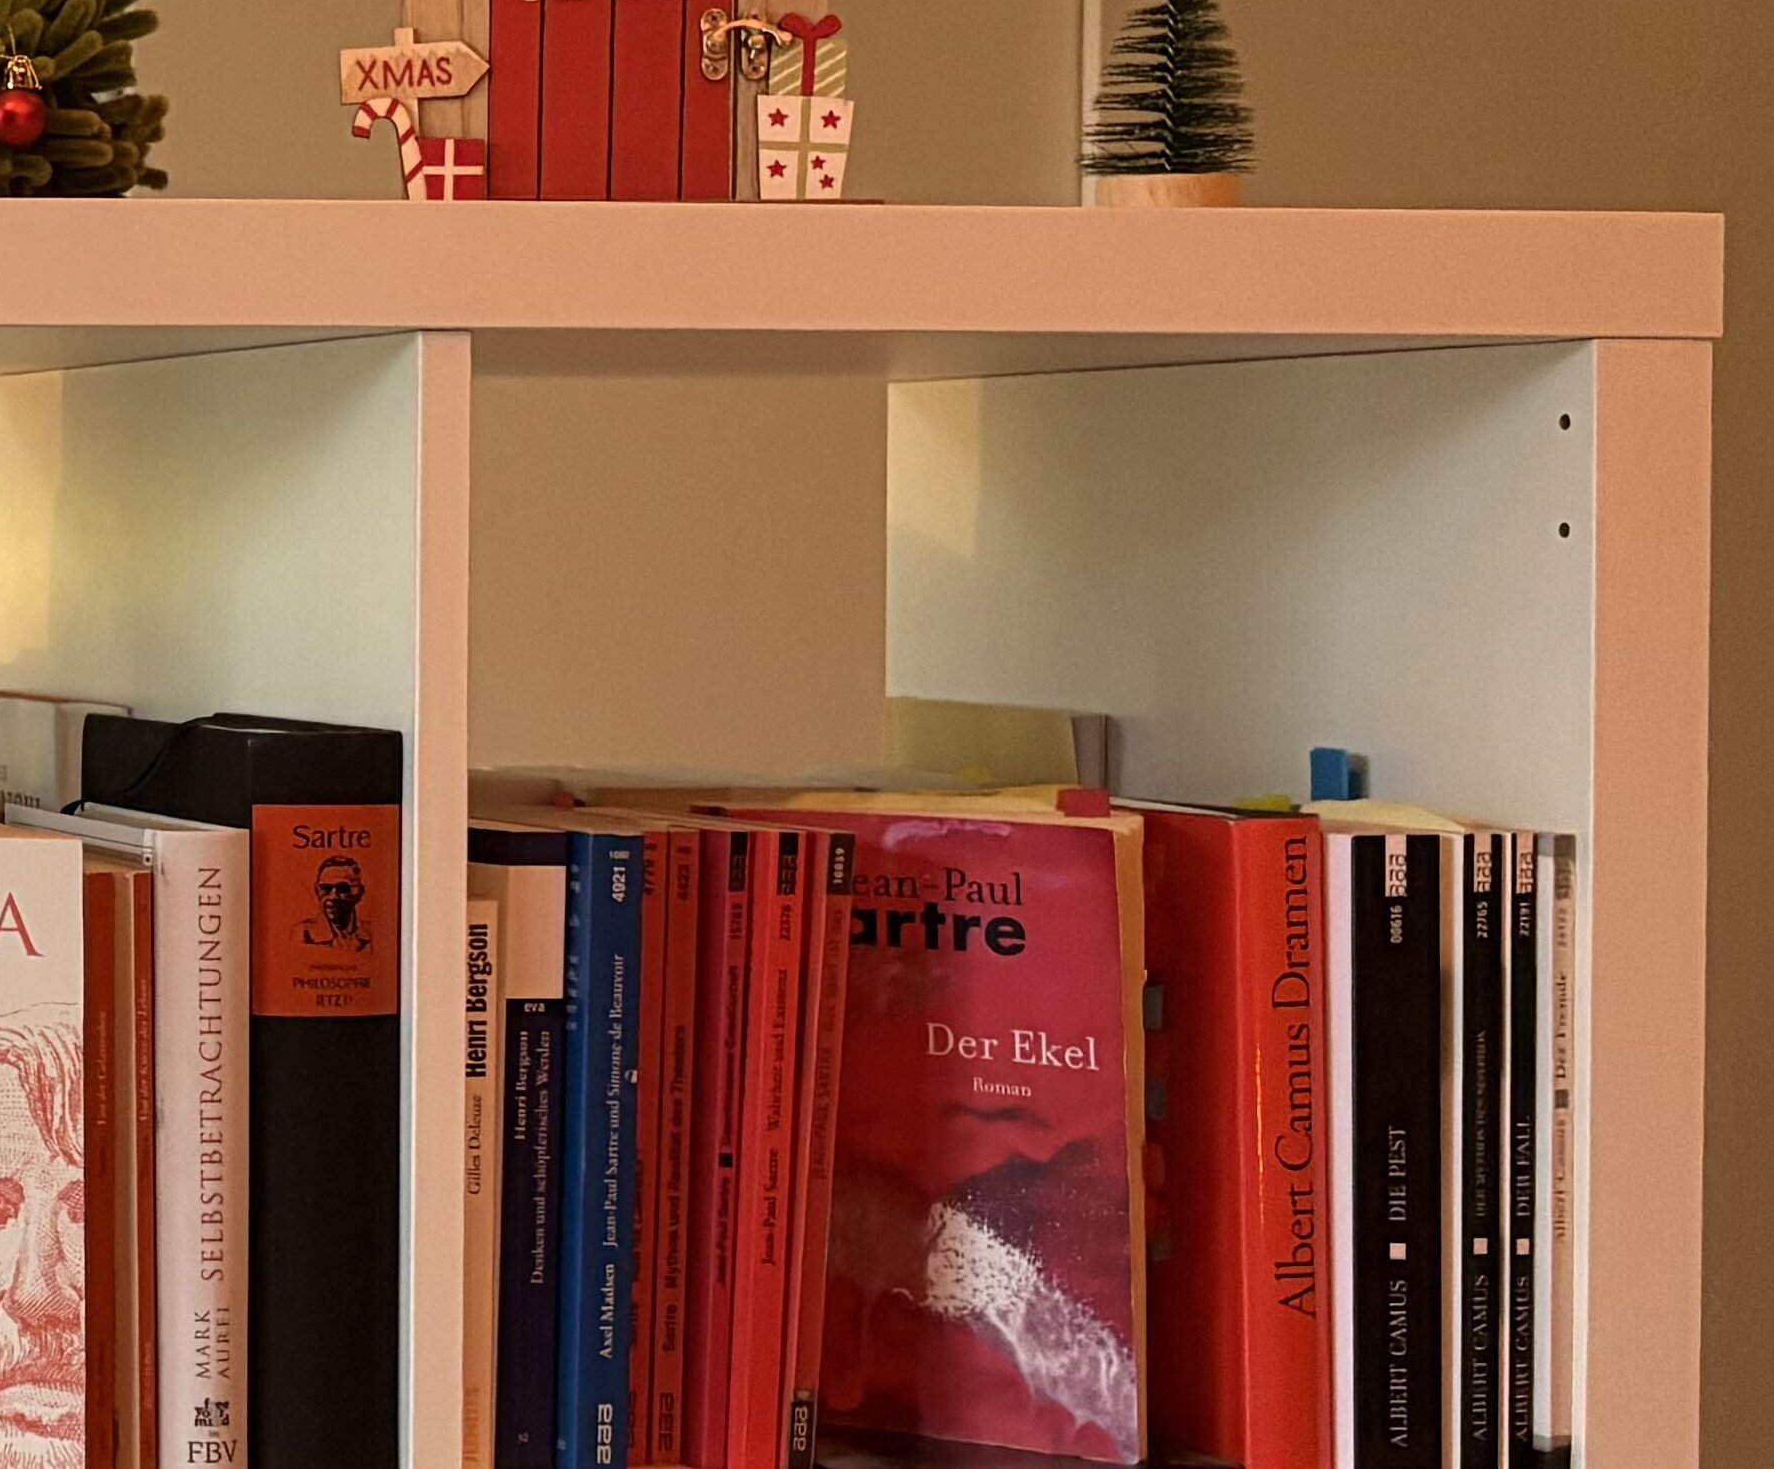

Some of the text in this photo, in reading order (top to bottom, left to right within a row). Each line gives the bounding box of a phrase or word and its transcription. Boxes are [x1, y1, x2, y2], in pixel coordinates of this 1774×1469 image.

[356, 57, 452, 91] XMAS
[292, 824, 372, 849] Sartre
[612, 867, 626, 902] 4921
[852, 867, 1024, 906] ean-Paul
[852, 902, 1026, 956] artre
[199, 866, 225, 1282] SELBSTBETRACHTUNGEN
[466, 923, 492, 1194] Gilles Deleuze Henri Bergson
[926, 1022, 1099, 1071] Der Ekel
[514, 1031, 530, 1139] Henri Bergson
[972, 1077, 1032, 1097] Roman
[1271, 836, 1317, 1320] Albert Camus Dramen
[600, 955, 624, 1358] Axel Madsen Jean-Paul Sartre und Simone de Beauvoir
[1388, 1127, 1408, 1448] ALBERT CAMUS DIE PEST
[194, 1310, 211, 1379] MARK
[1473, 1274, 1488, 1440] ALBERT CAMUS
[187, 1439, 237, 1463] FBV
